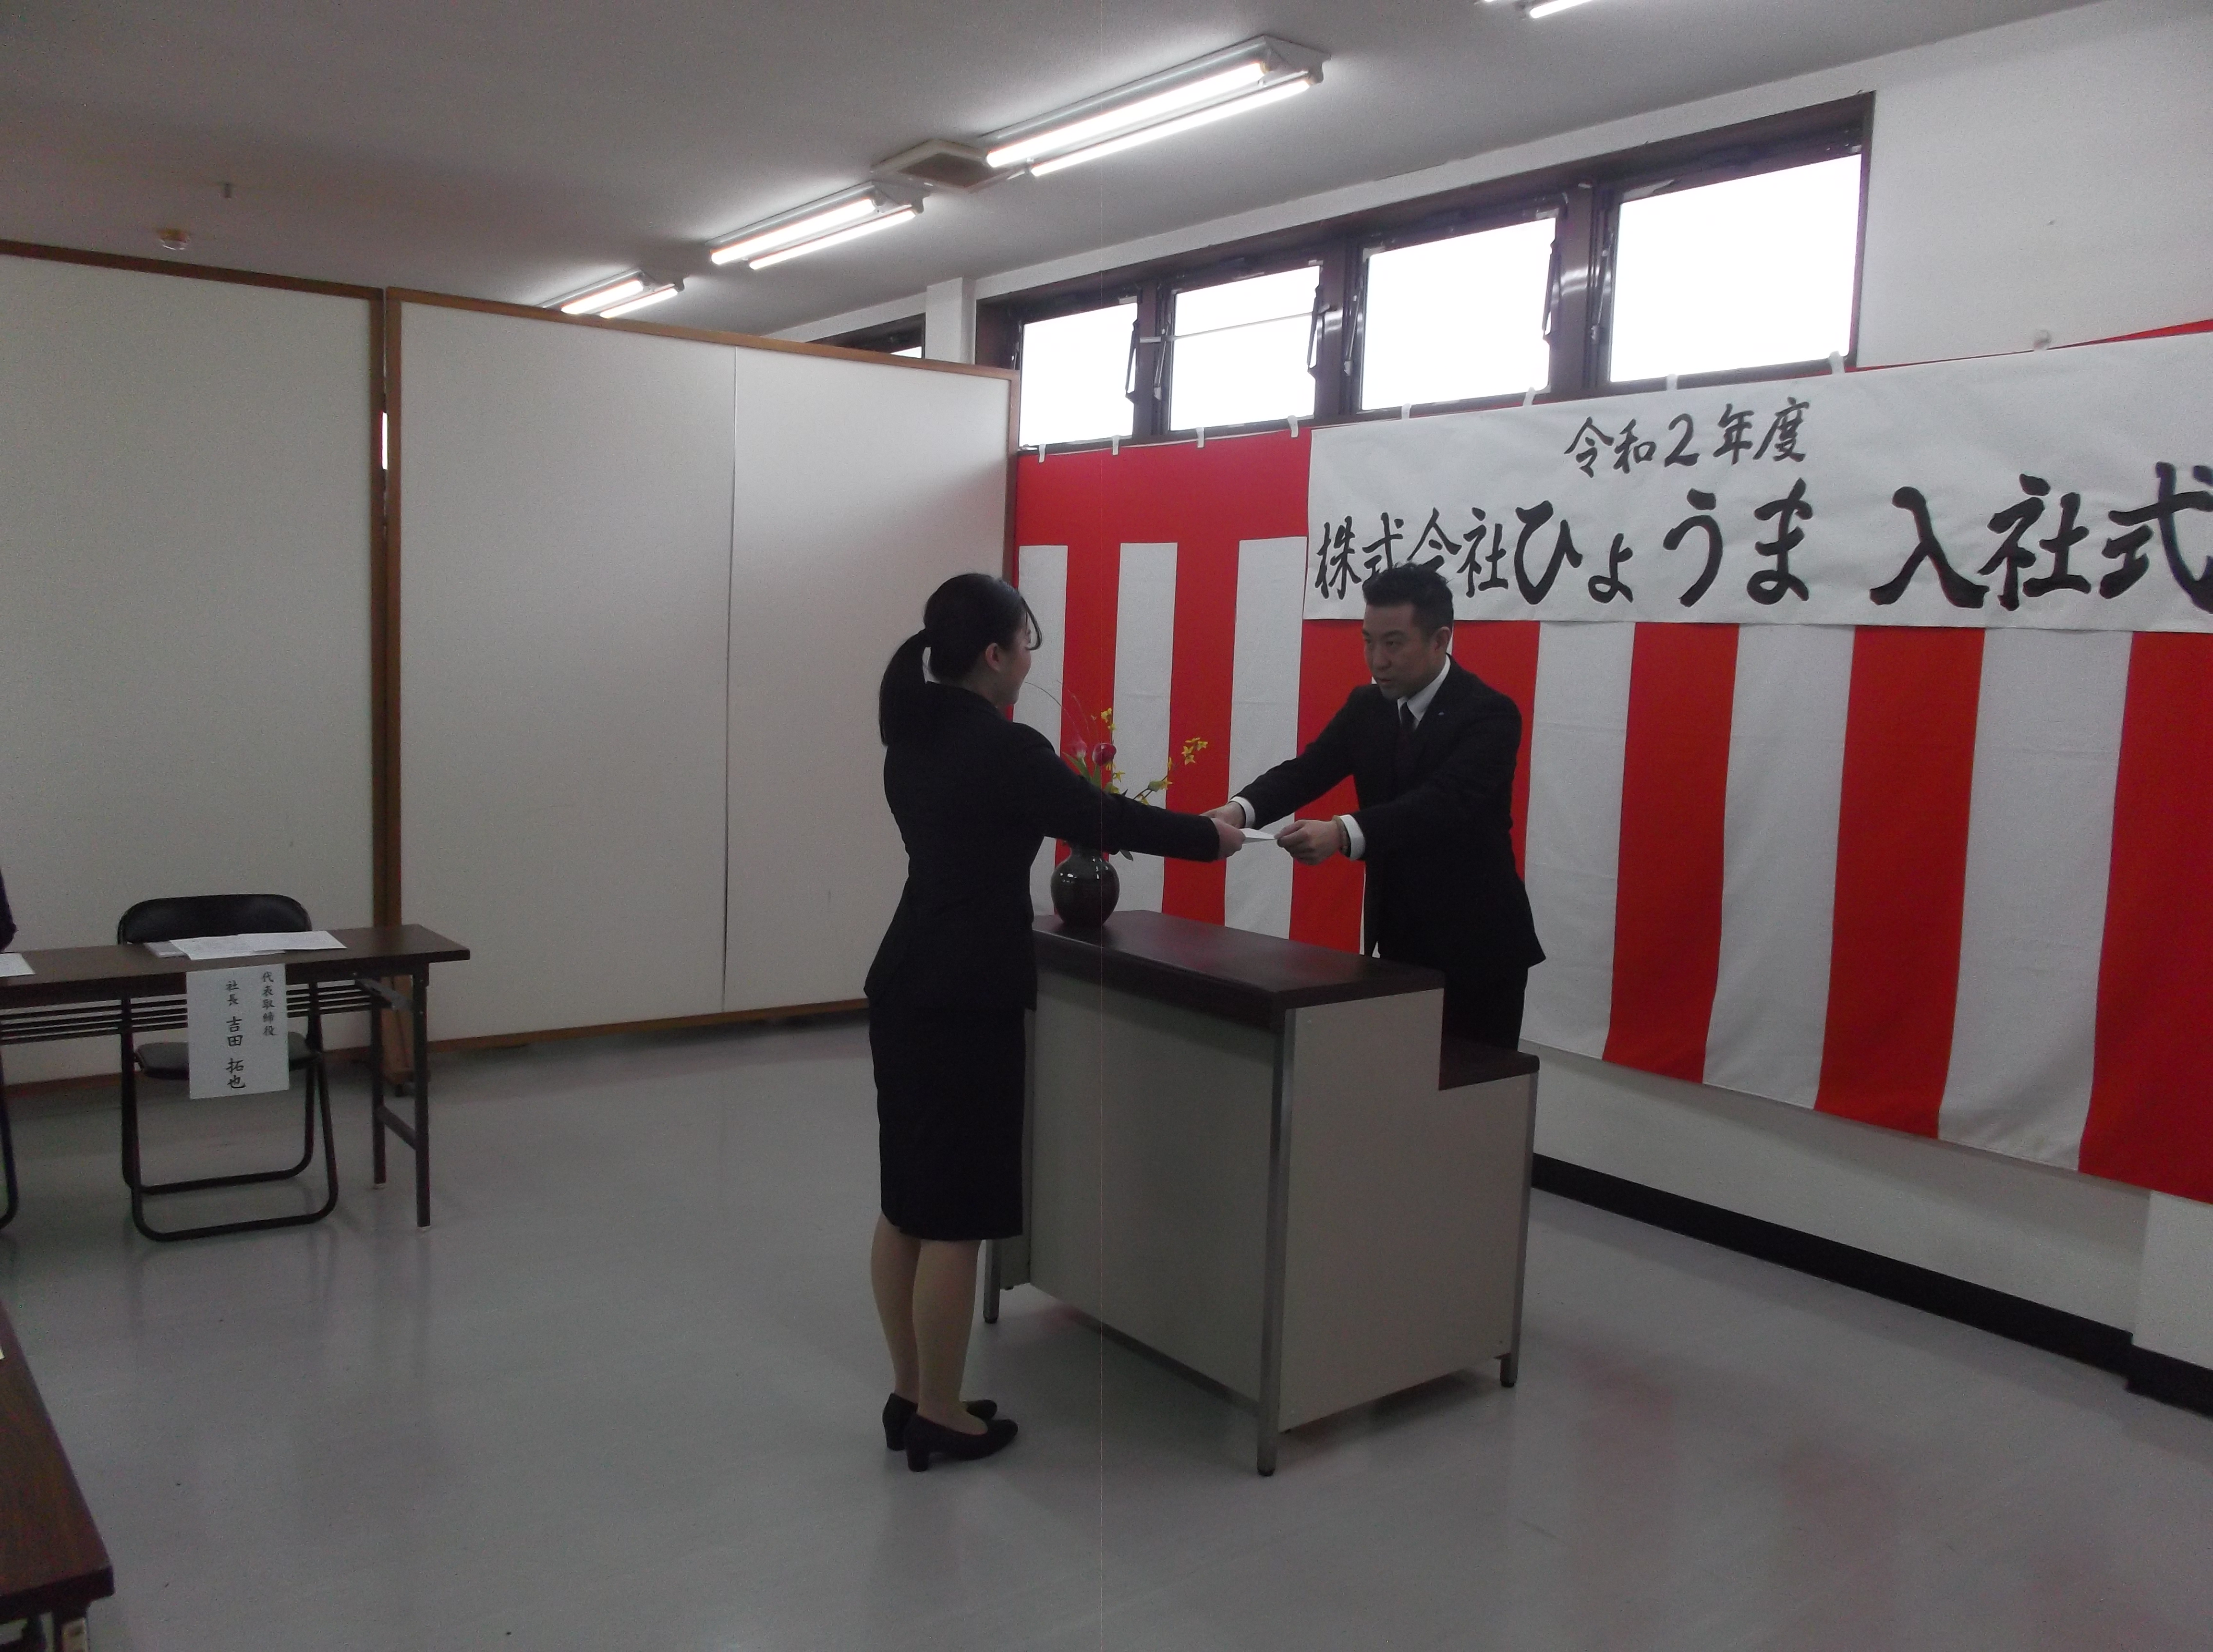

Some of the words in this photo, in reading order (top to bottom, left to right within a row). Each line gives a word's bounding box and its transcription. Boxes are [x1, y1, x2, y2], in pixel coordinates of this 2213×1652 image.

[1564, 397, 1810, 478] 令和2年度
[1870, 462, 2213, 614] 入社式
[226, 980, 239, 1006] 社長
[262, 971, 278, 1036] 代表取締役
[226, 1016, 243, 1046] 吉田
[226, 1058, 246, 1089] 拓也
